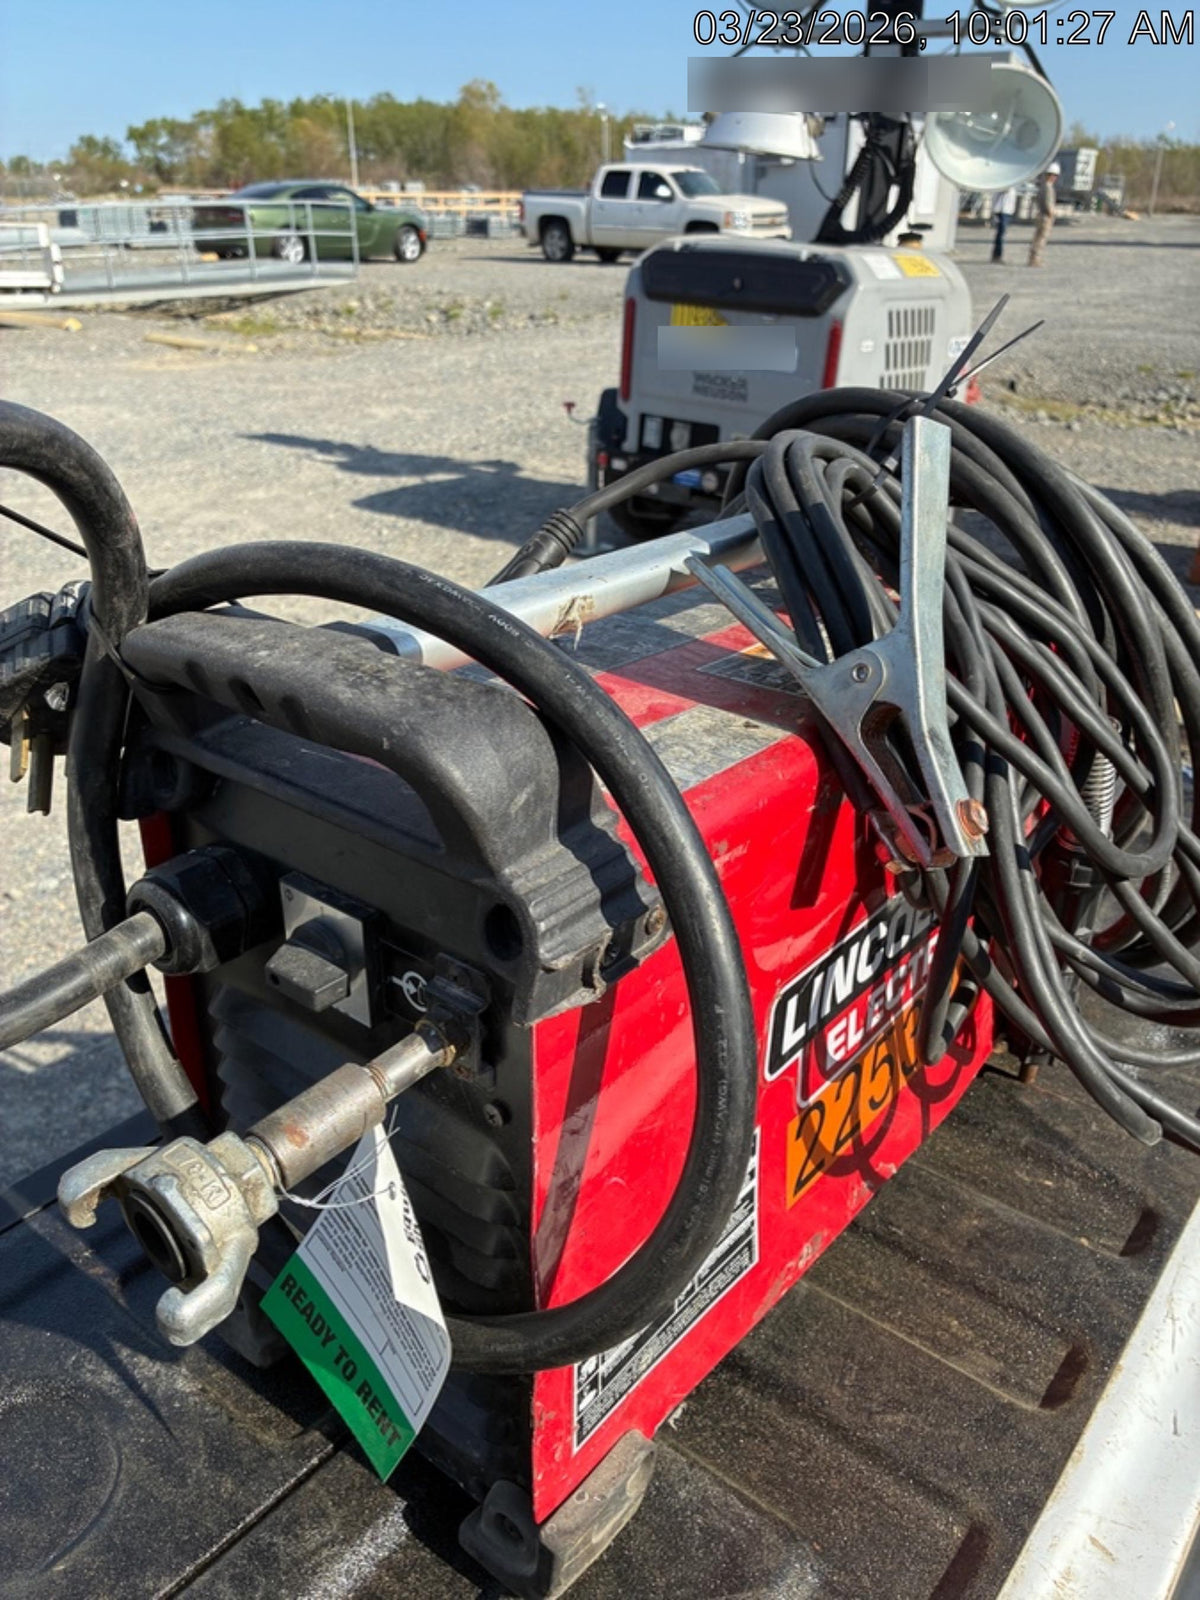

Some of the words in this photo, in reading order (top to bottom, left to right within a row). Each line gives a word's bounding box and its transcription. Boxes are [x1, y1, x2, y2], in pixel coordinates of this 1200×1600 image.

[782, 898, 939, 1056] LINCOL
[280, 1273, 337, 1349] READY
[333, 1344, 358, 1392] TO
[355, 1379, 402, 1448] RENT
